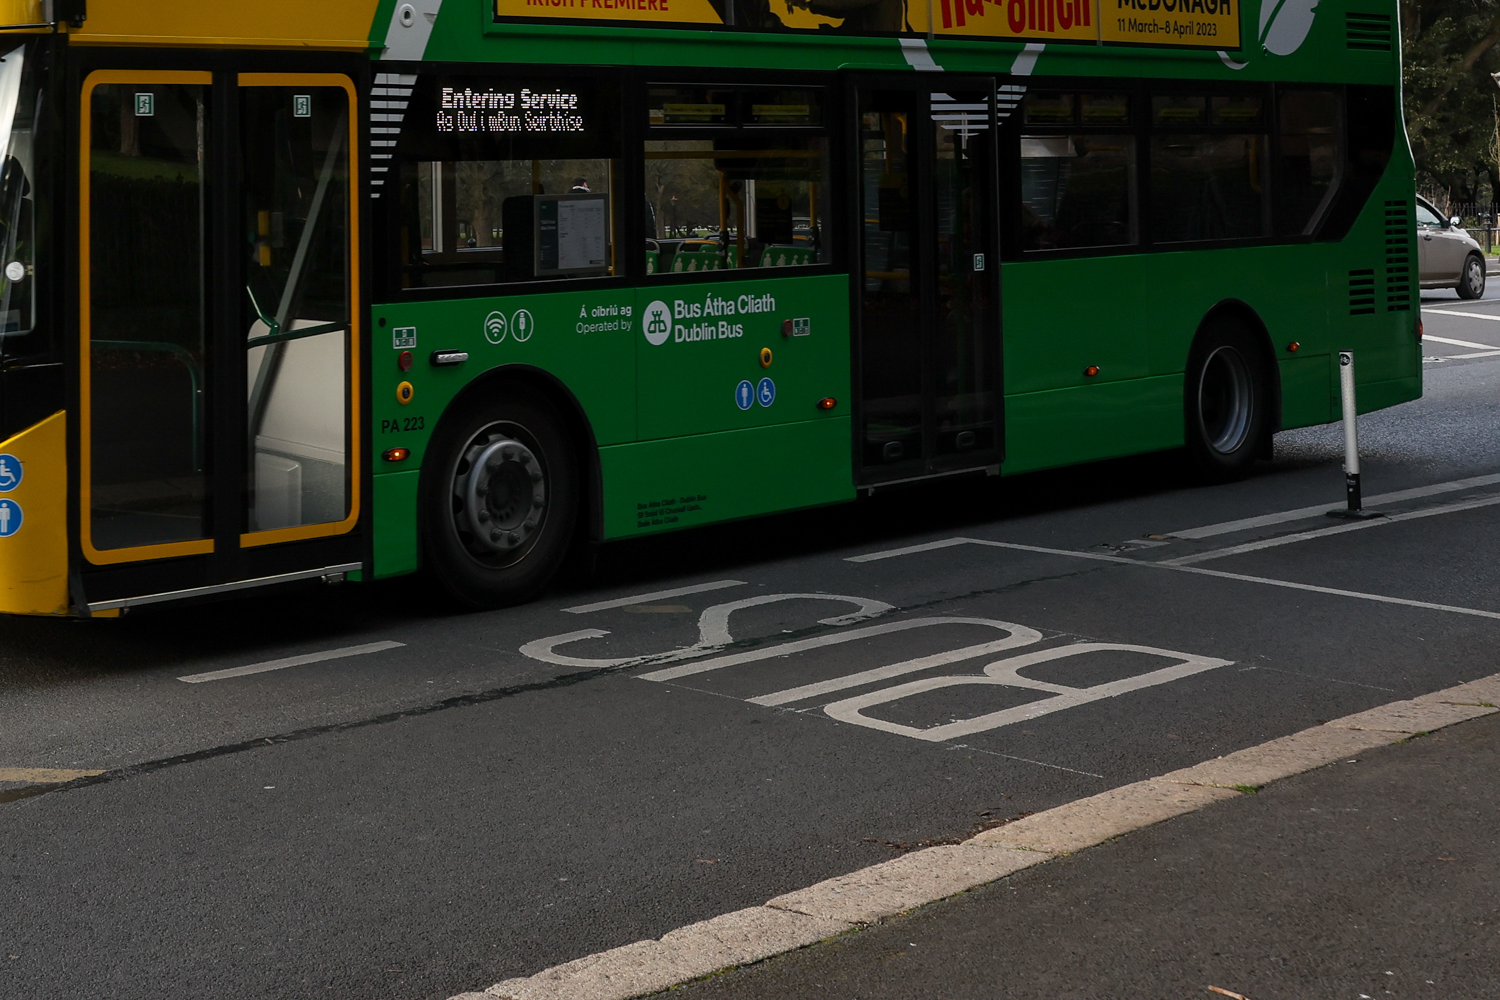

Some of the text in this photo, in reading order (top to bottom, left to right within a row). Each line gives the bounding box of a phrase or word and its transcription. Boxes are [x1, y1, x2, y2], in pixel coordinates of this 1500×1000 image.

[1117, 18, 1126, 32] 11
[1172, 20, 1195, 39] April
[1195, 21, 1218, 38] 2023
[441, 87, 578, 110] Entering Service
[436, 110, 454, 132] Ag
[457, 110, 478, 132] Dul
[481, 110, 486, 132] i
[488, 110, 522, 132] mBun
[579, 304, 633, 319] Á oibriú ag
[673, 292, 776, 320] Bus Átha Cliath
[575, 319, 633, 335] Operated by
[673, 321, 744, 343] Dublin Bus
[381, 416, 425, 433] PA 223
[518, 592, 1237, 743] BUS
